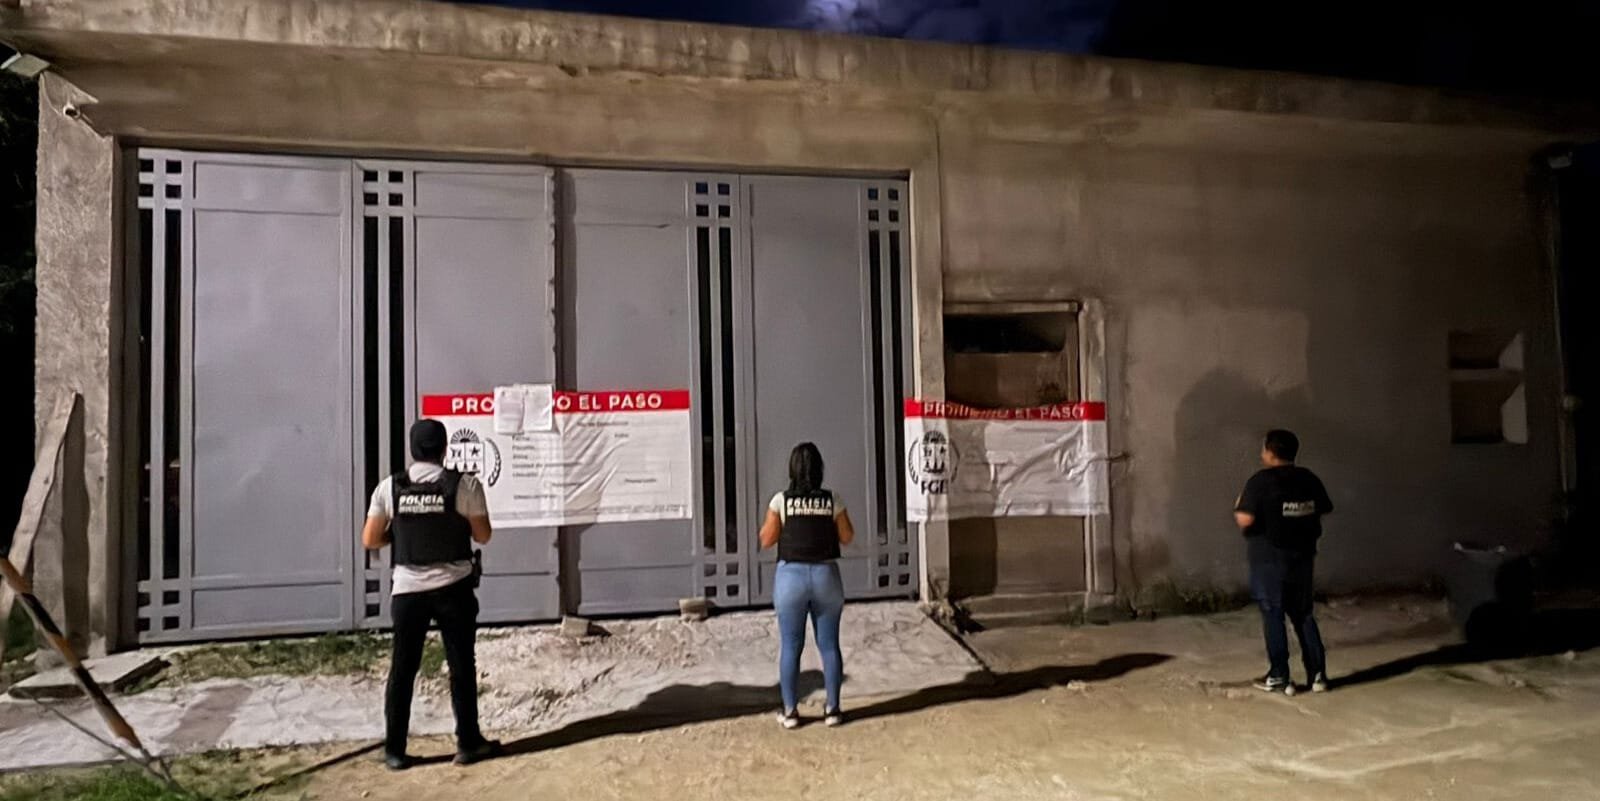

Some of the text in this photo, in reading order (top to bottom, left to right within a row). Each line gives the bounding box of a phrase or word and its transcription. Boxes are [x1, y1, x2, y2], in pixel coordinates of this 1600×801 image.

[579, 395, 602, 410] EL
[609, 393, 662, 410] PASO
[1040, 404, 1085, 419] PASO
